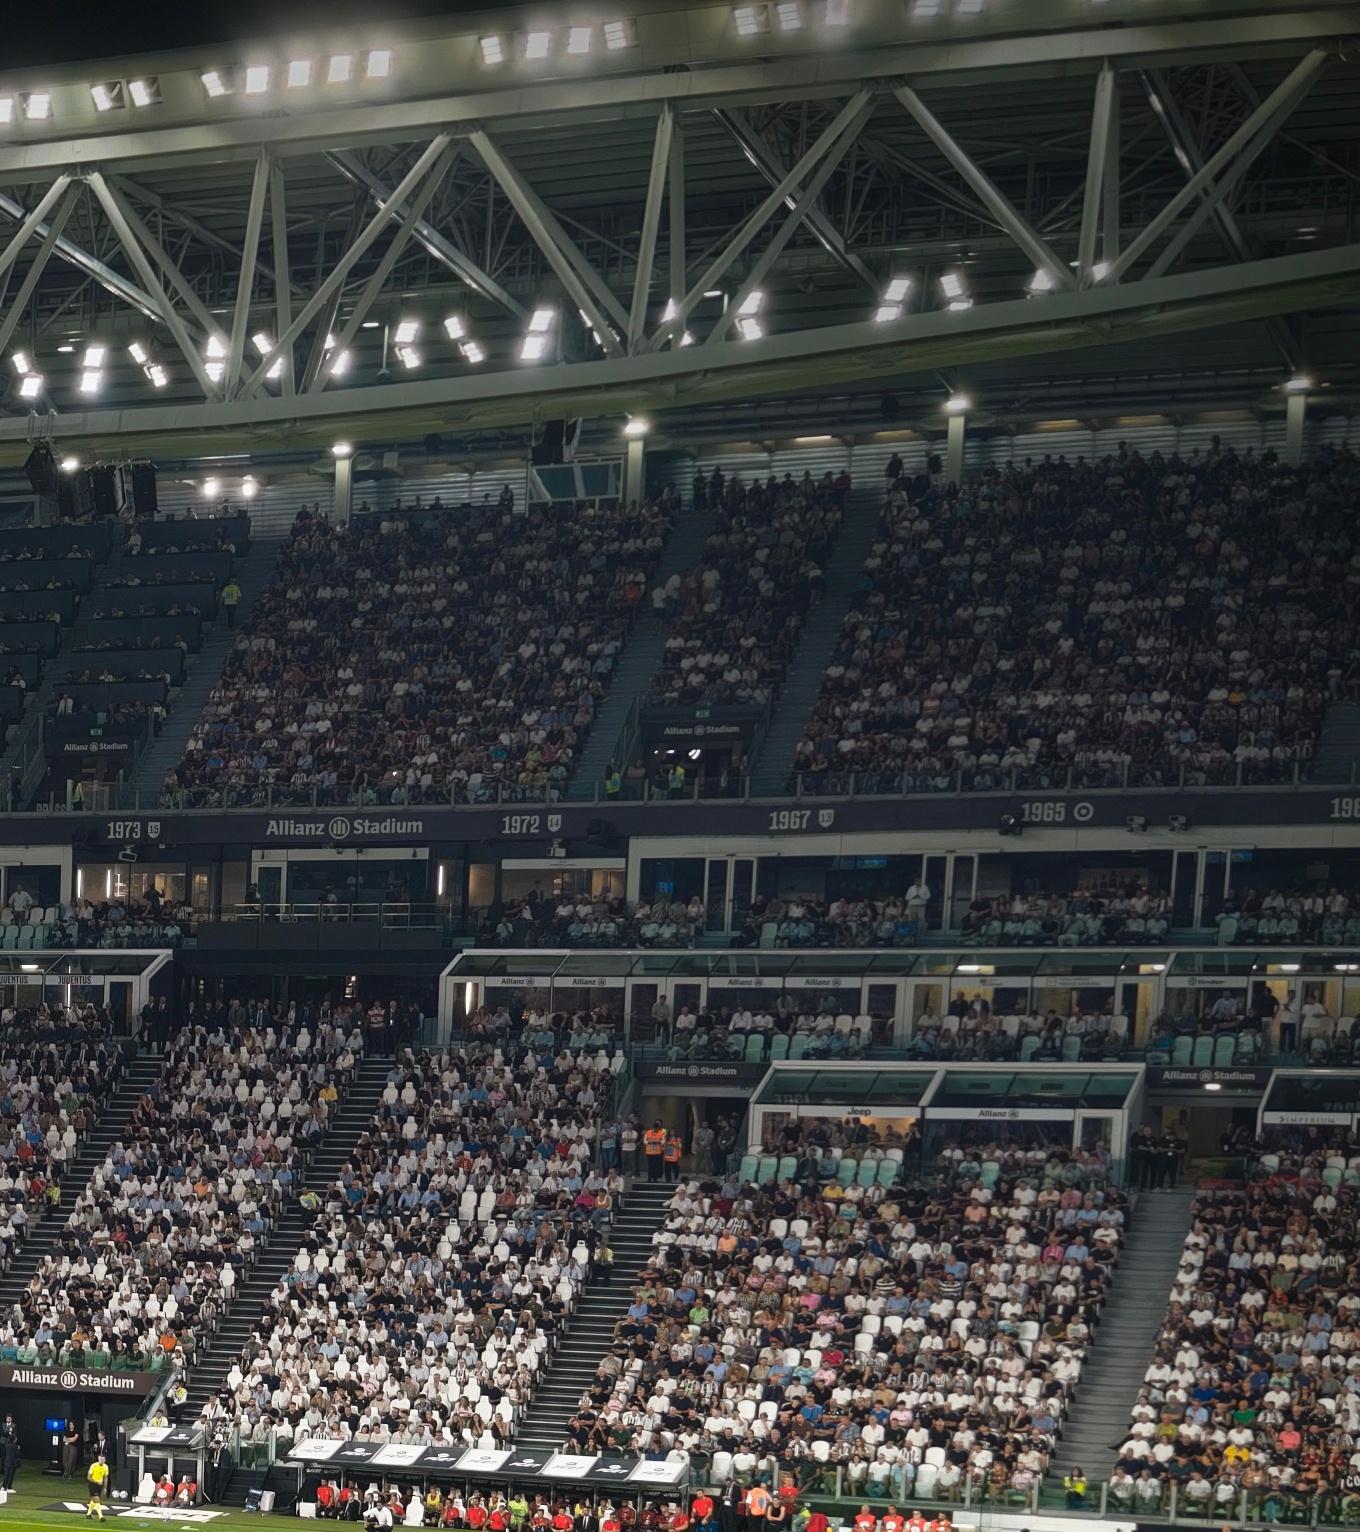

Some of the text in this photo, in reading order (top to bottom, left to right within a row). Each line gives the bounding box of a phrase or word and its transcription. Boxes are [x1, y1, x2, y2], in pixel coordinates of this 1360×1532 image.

[664, 725, 740, 736] Allianz Stadium
[64, 743, 89, 751] Allianz
[1021, 803, 1067, 822] 1965
[502, 816, 540, 833] 1972
[769, 810, 811, 830] 1967
[107, 821, 141, 838] 1973
[266, 819, 423, 836] Allianz Stadium
[58, 976, 92, 984] JUVENTUS
[572, 978, 596, 986] Allianz
[728, 978, 752, 986] Allianz
[805, 978, 829, 986] Allianz
[656, 1067, 736, 1075] Allianz Stadium
[1162, 1071, 1255, 1080] Allianz Stadium
[847, 1107, 871, 1117] Jeep
[978, 1109, 1007, 1117] Allianz
[11, 1370, 134, 1389] Allianz Stadium
